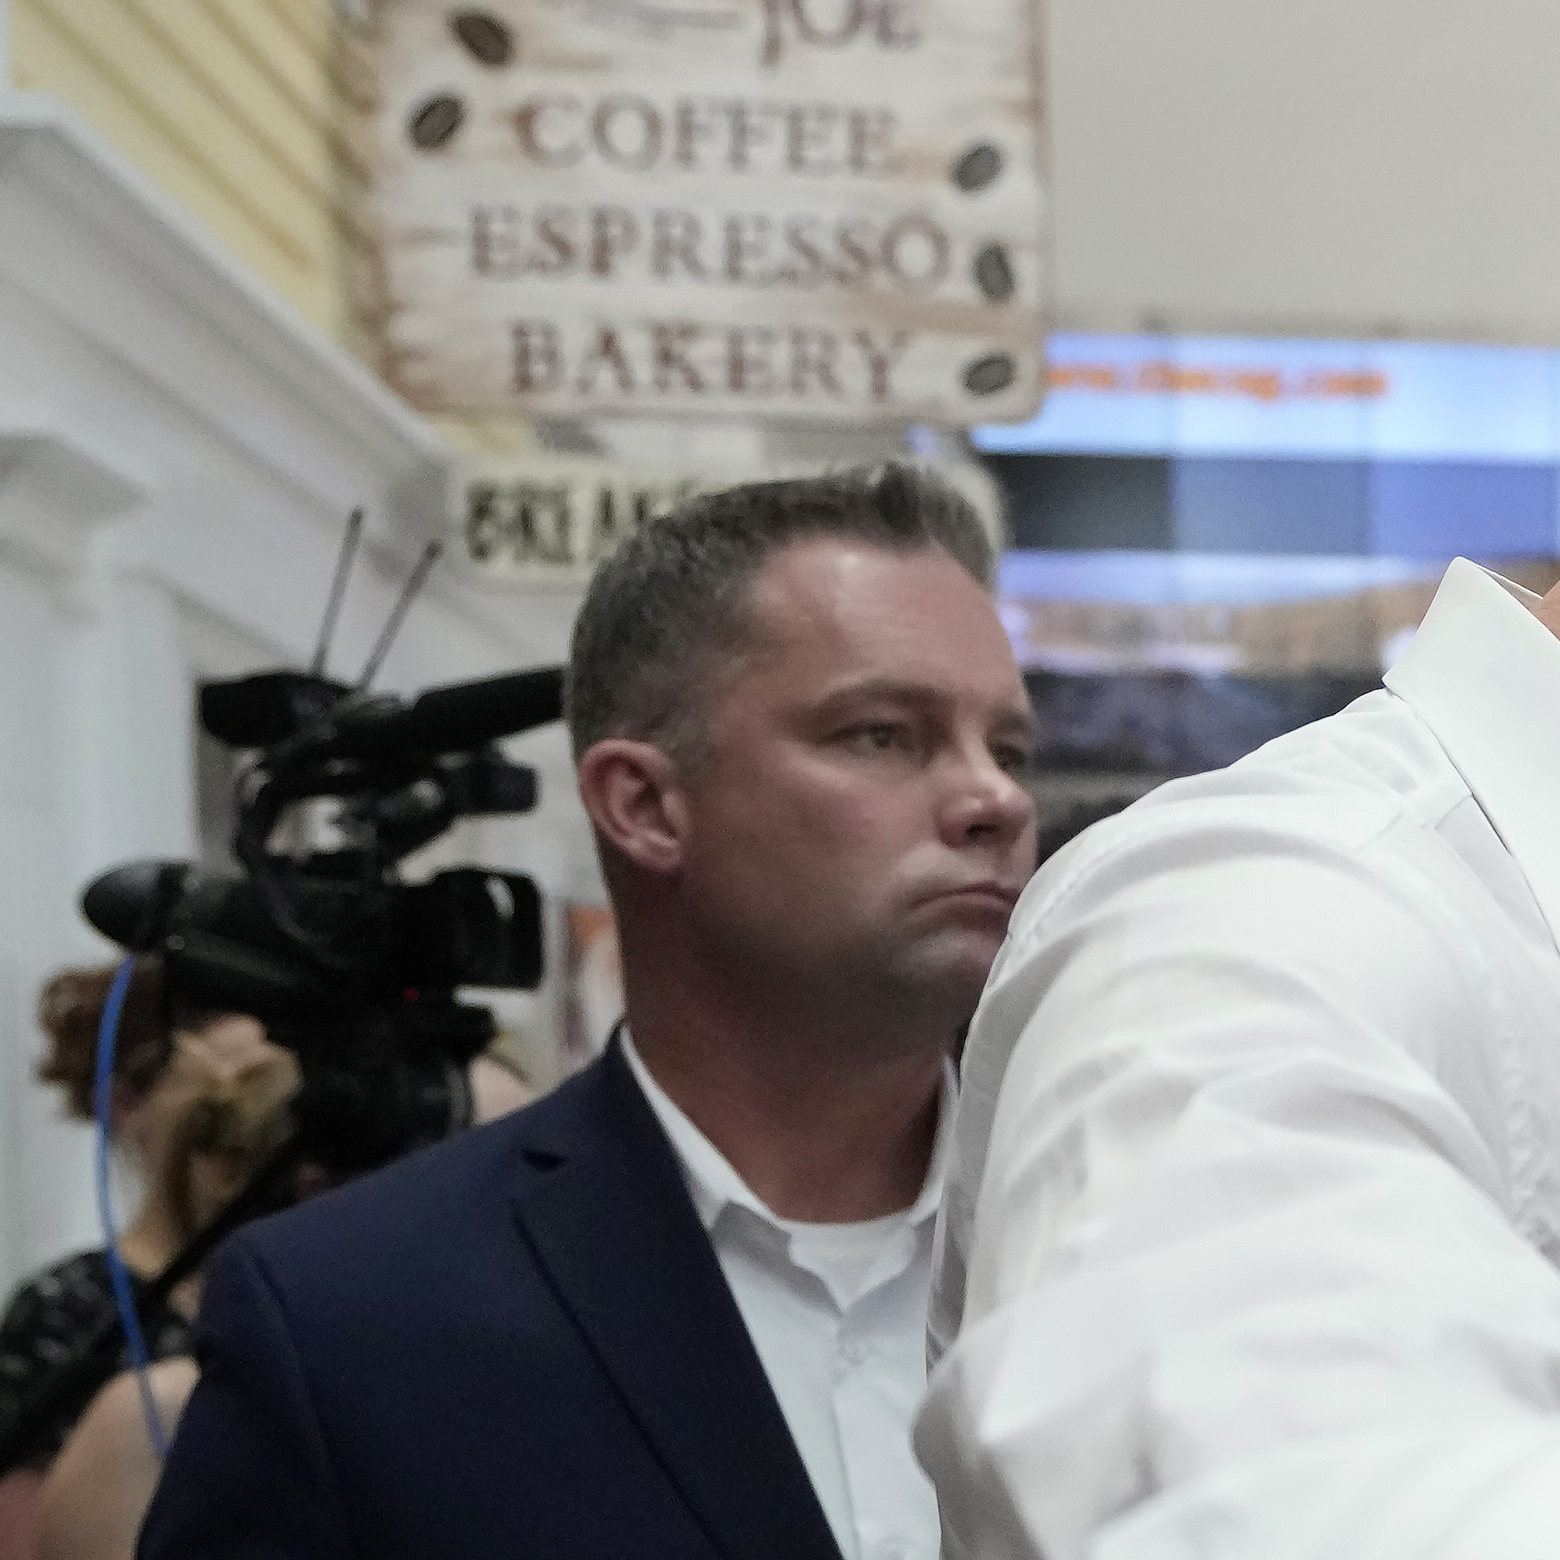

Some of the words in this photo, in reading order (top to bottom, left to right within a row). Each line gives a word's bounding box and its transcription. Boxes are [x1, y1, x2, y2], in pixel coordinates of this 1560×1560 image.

[510, 93, 897, 173] COFFEE
[468, 206, 953, 291] ESPRESSO
[509, 319, 907, 399] BAKERY
